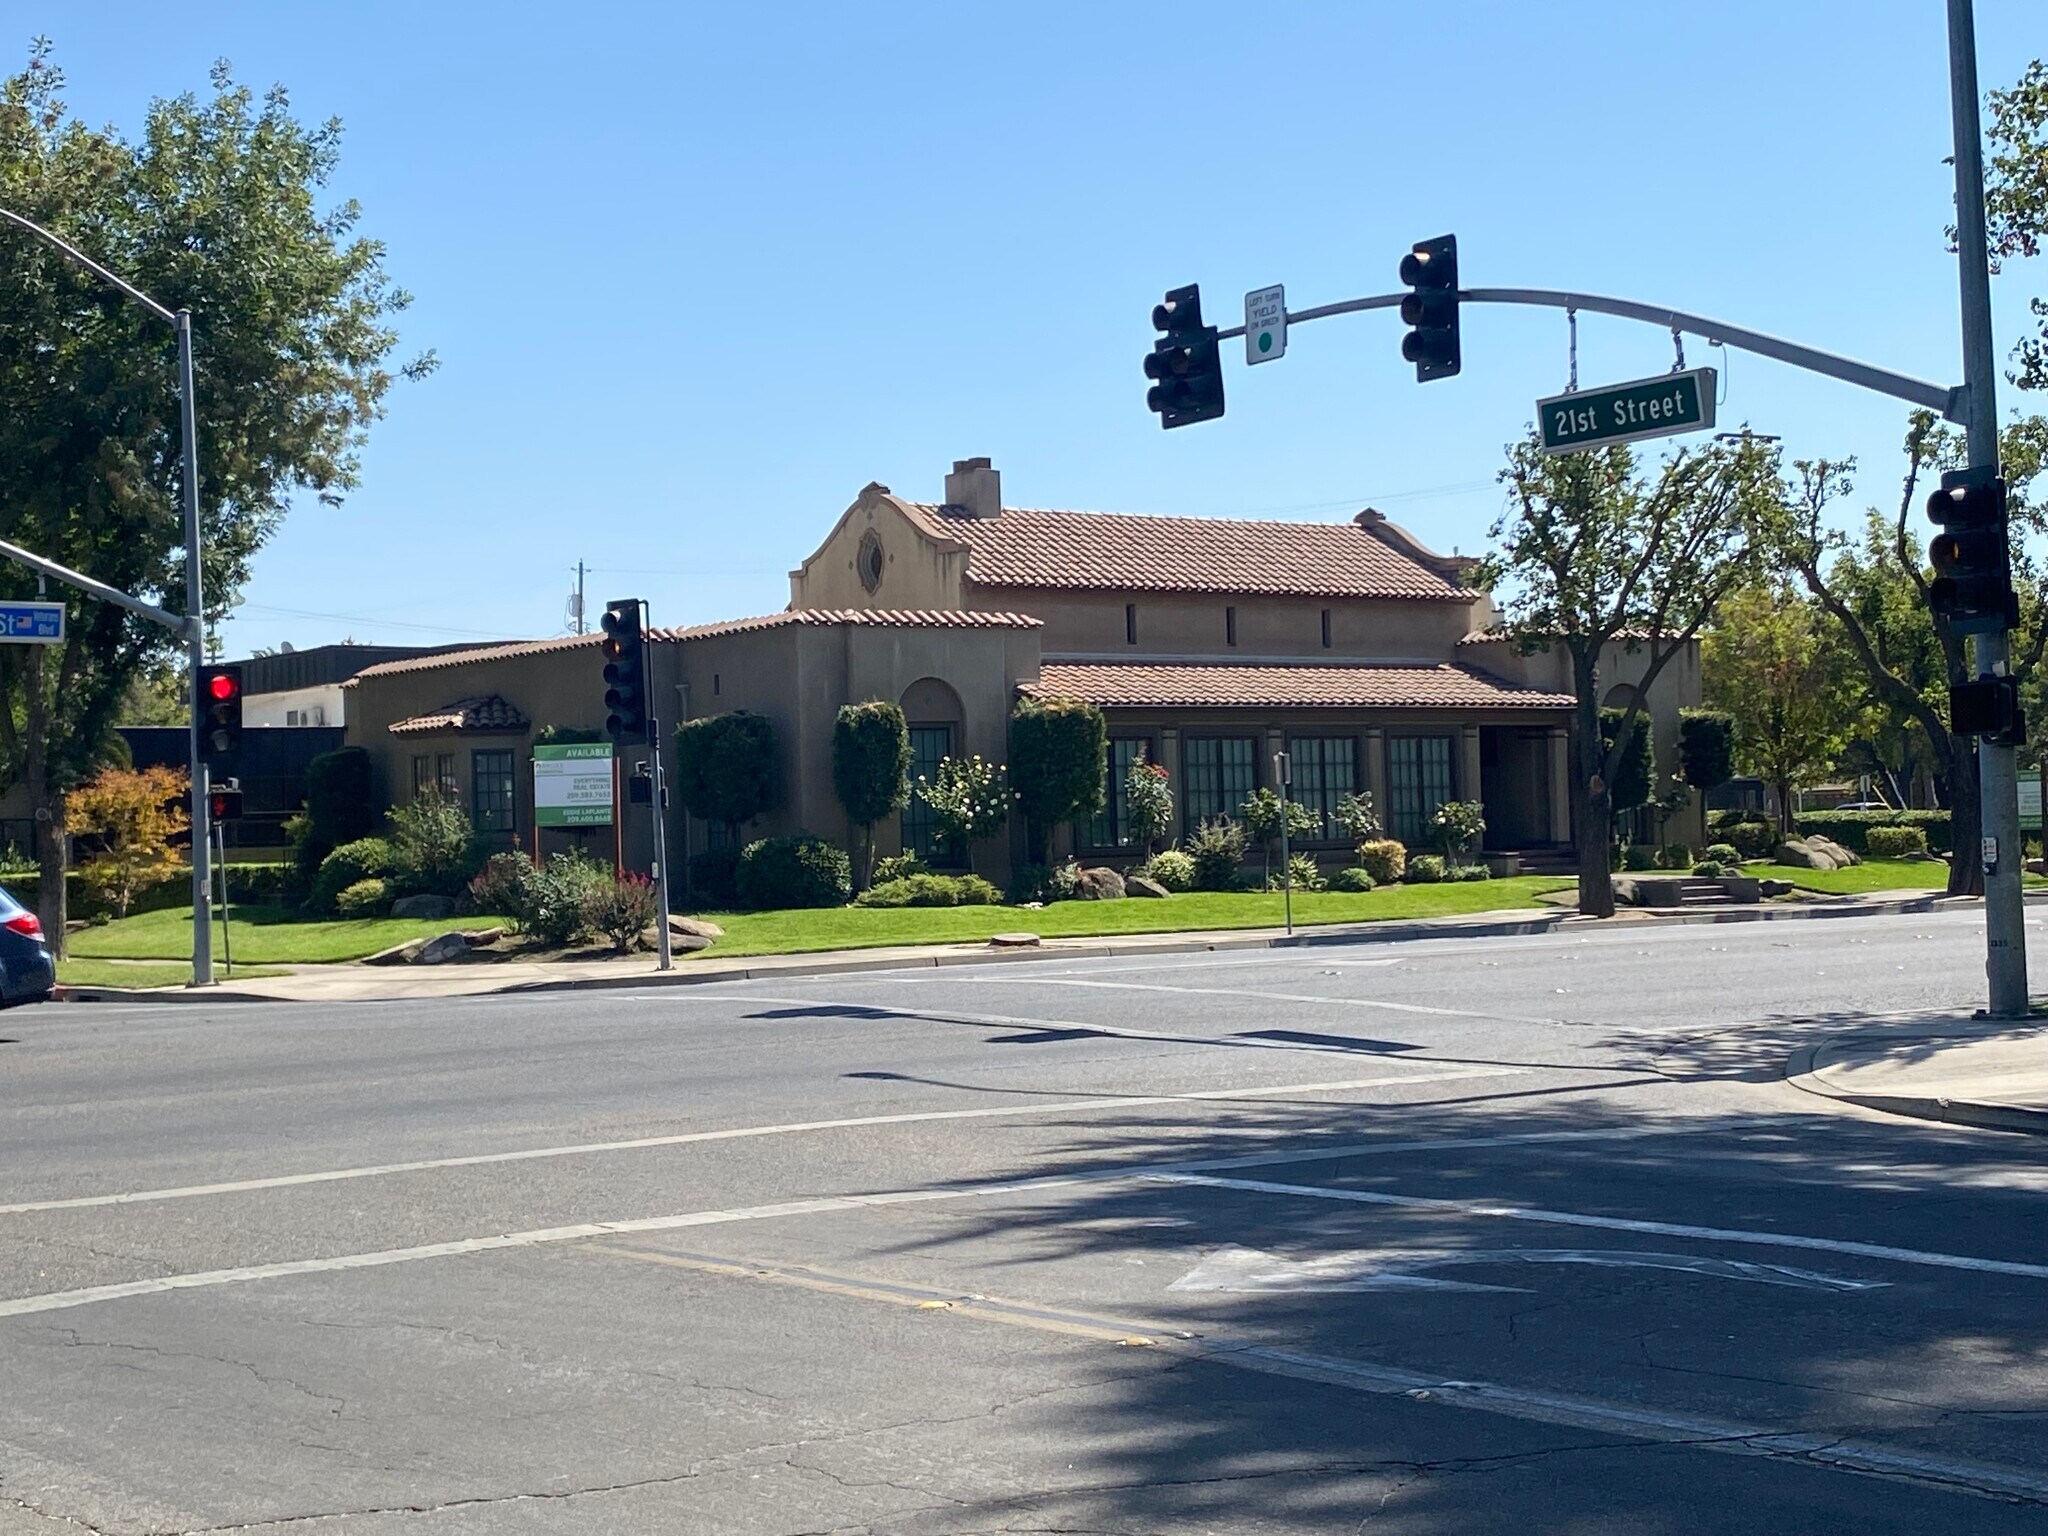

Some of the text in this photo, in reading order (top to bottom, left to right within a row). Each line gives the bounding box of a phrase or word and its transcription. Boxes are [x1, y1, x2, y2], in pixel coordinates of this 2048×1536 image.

[1252, 304, 1277, 318] YIELD
[1555, 390, 1685, 437] 21st Street
[566, 748, 610, 757] AVAILABLE
